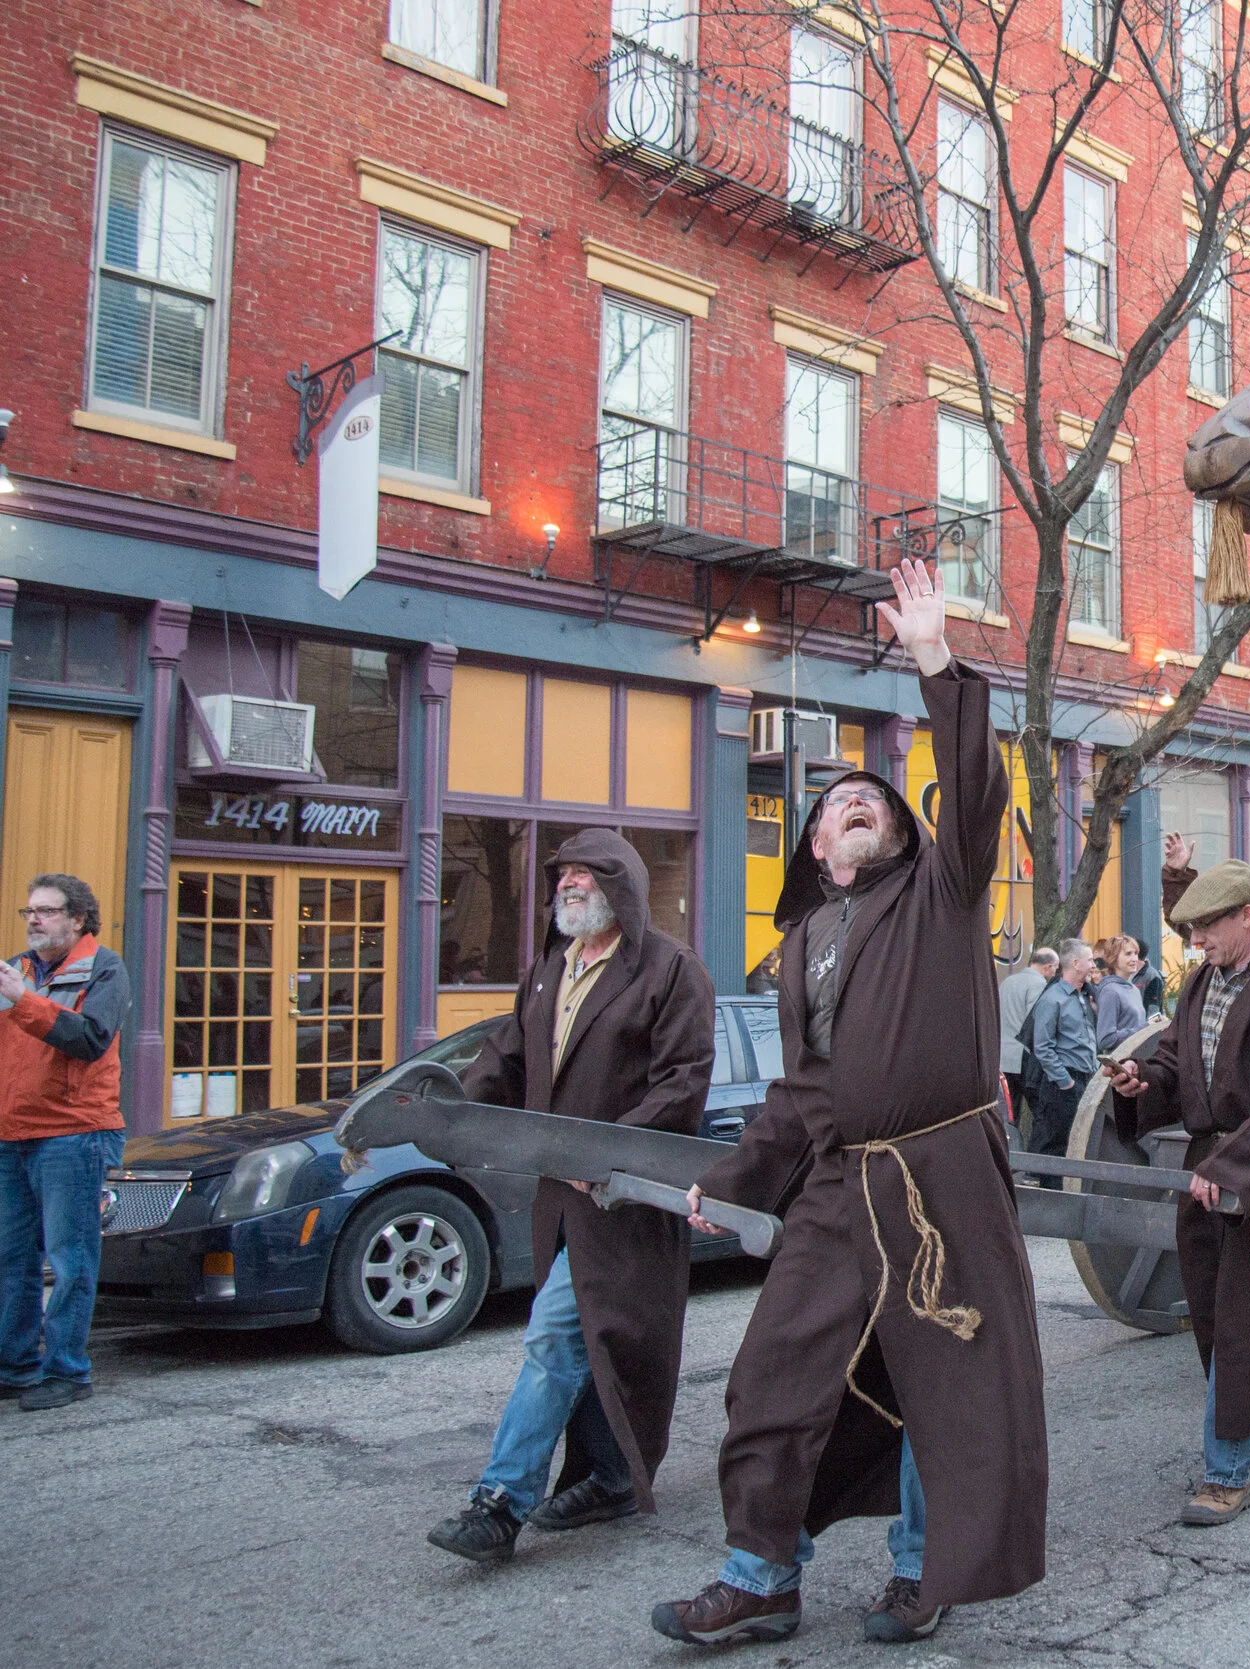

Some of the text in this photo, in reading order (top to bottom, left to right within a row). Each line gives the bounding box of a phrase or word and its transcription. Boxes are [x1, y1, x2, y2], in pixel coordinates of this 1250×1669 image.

[346, 418, 370, 438] 1414
[747, 796, 778, 817] 412
[204, 799, 381, 837] 1414 MAIN
